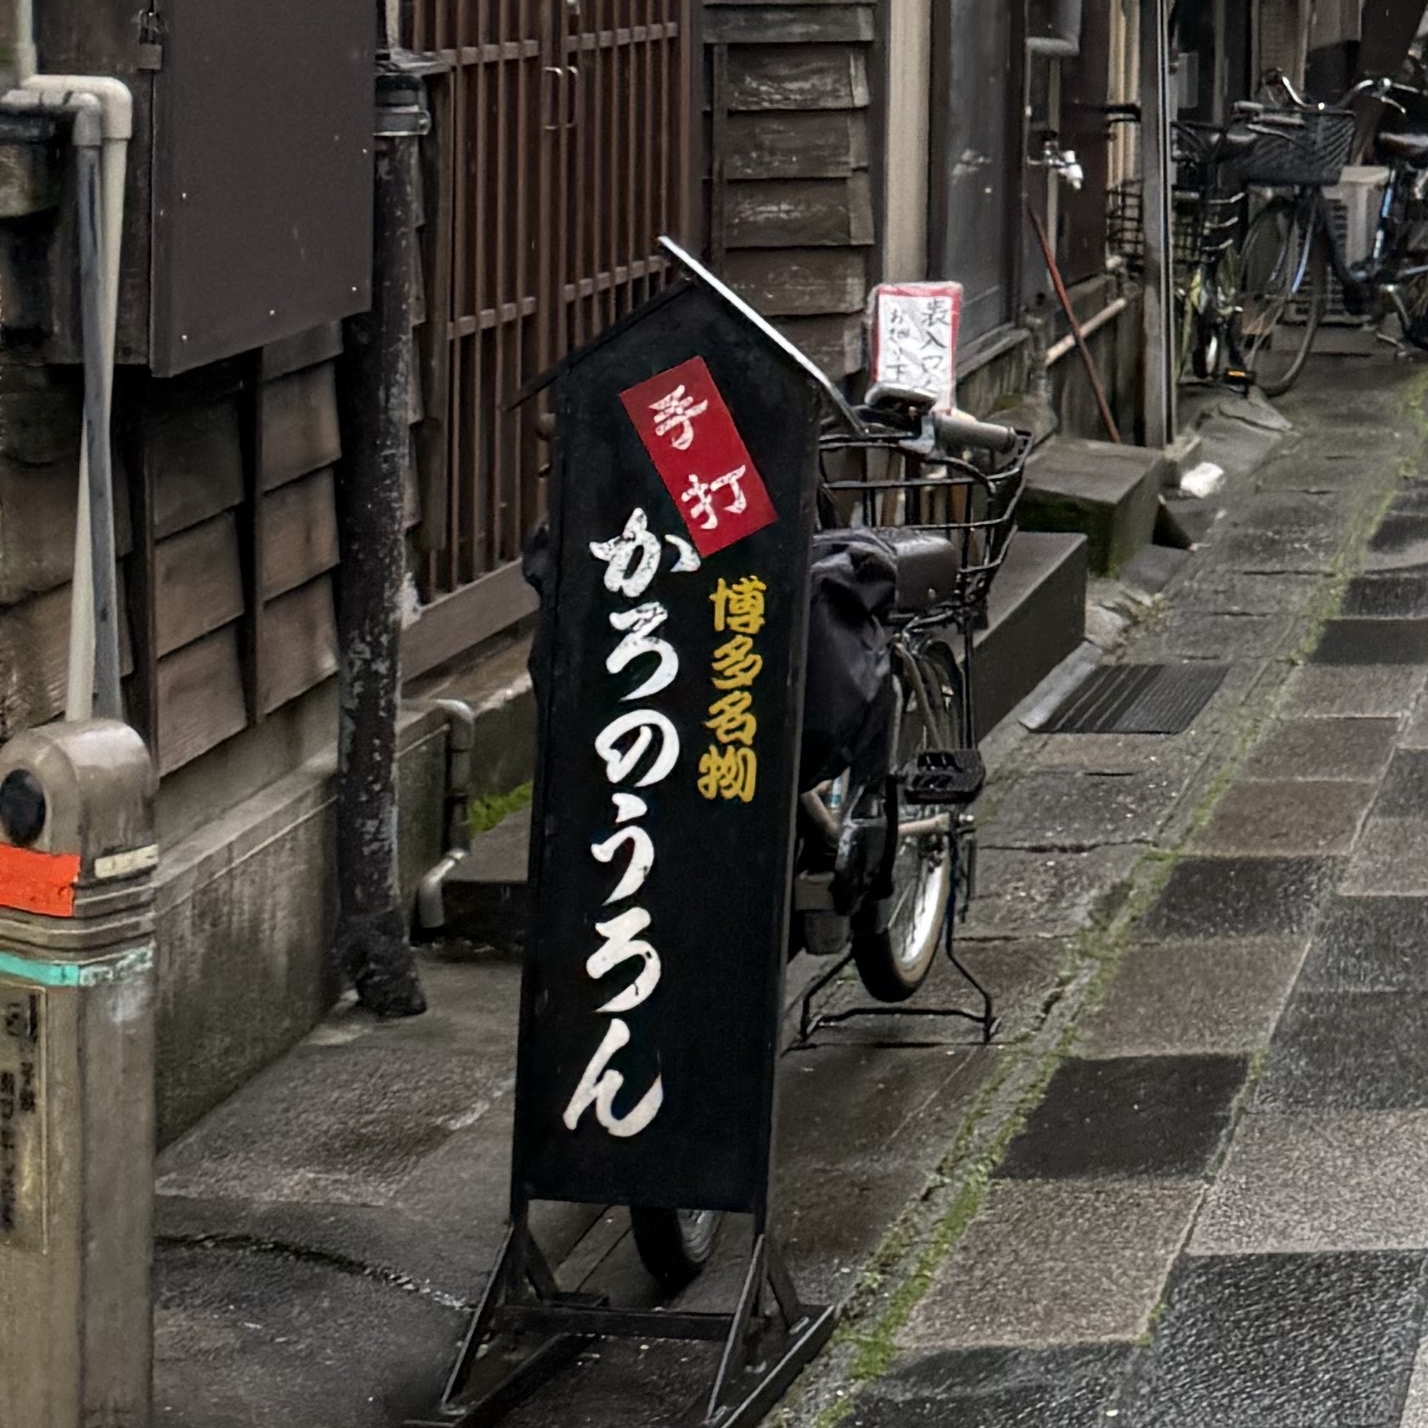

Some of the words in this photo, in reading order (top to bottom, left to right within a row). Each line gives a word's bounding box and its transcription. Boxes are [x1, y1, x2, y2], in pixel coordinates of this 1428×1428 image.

[648, 383, 750, 531] 手打
[696, 574, 768, 804] 博多名物
[561, 506, 703, 1138] かろのうろん
